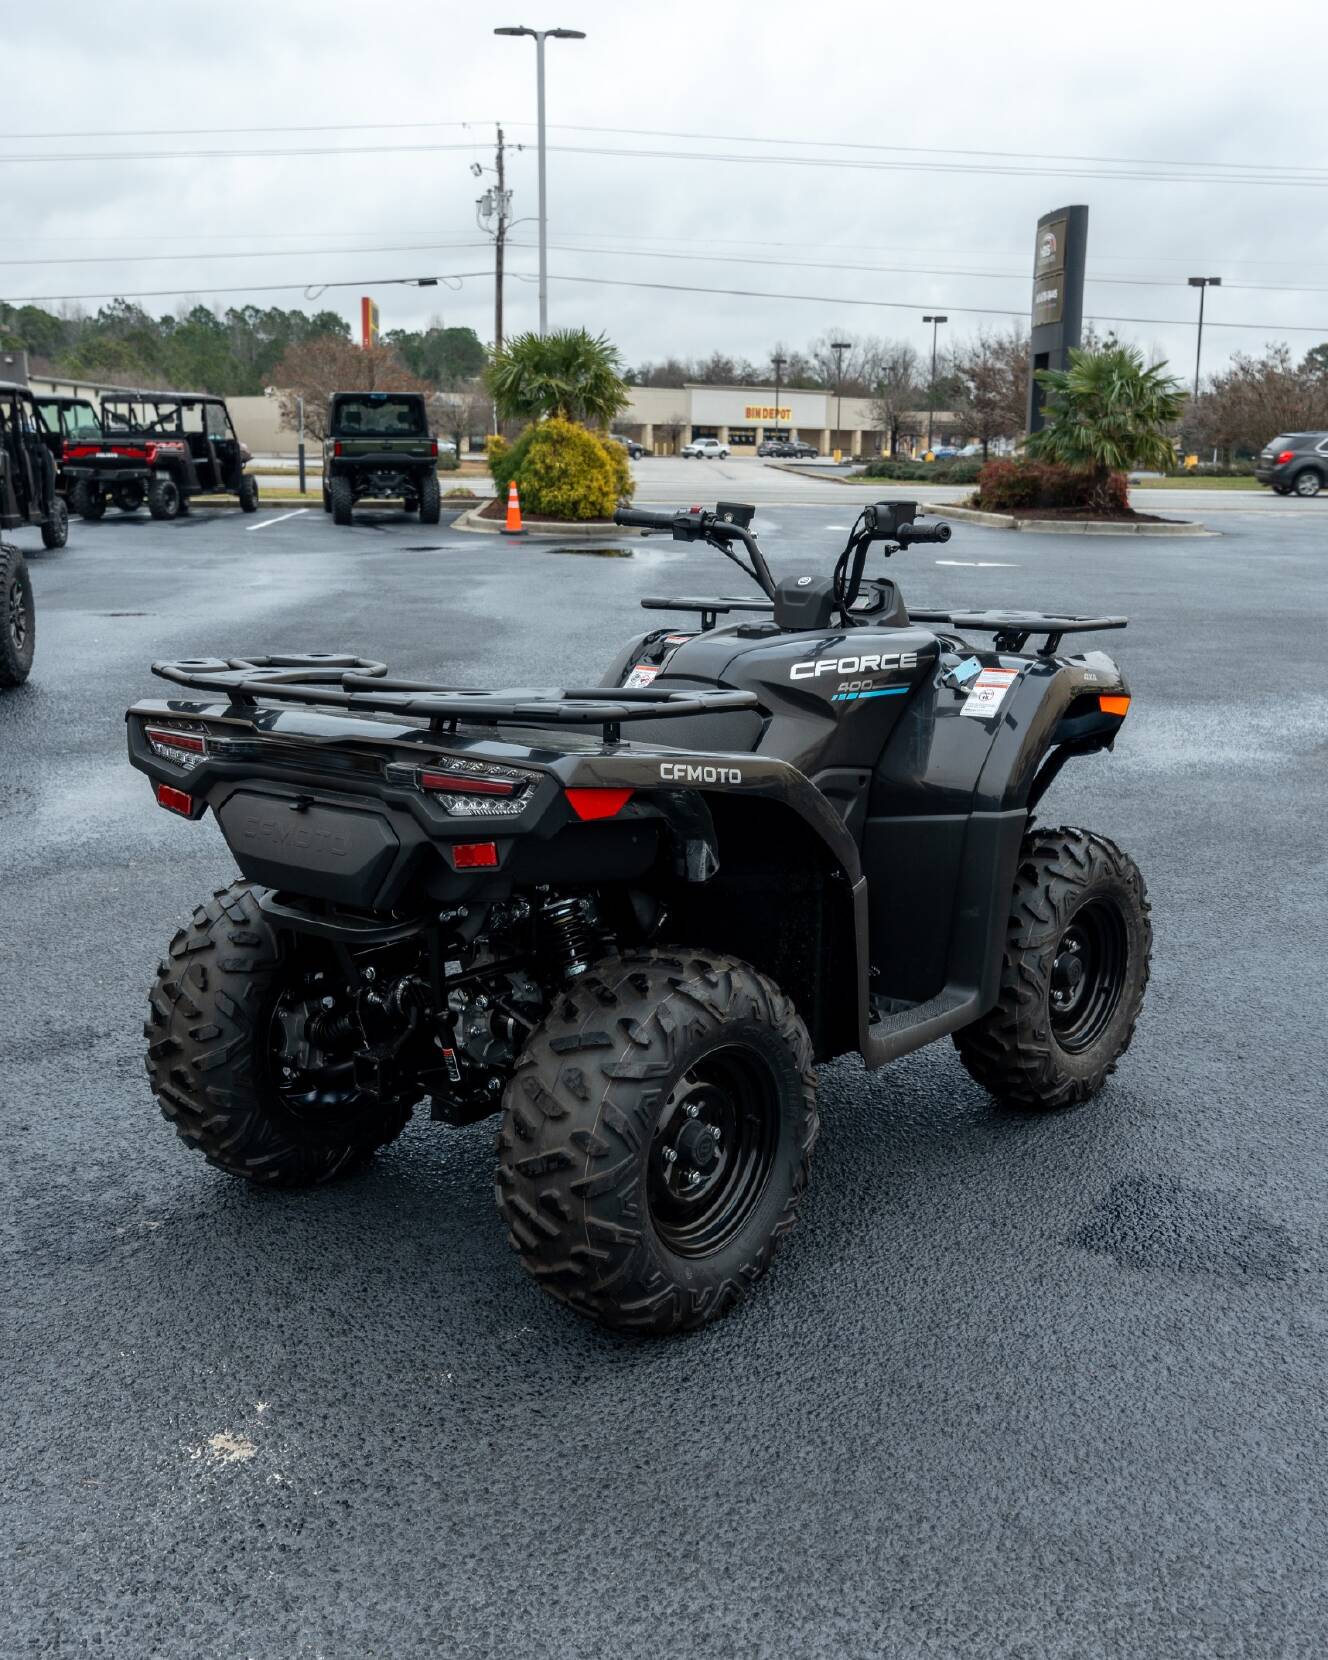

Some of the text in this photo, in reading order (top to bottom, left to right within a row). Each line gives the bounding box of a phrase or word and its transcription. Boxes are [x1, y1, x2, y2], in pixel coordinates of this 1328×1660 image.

[745, 407, 791, 420] BIN DEPOT
[790, 652, 917, 680] CFORCE
[838, 680, 873, 692] 400
[660, 763, 741, 784] CFMOTO
